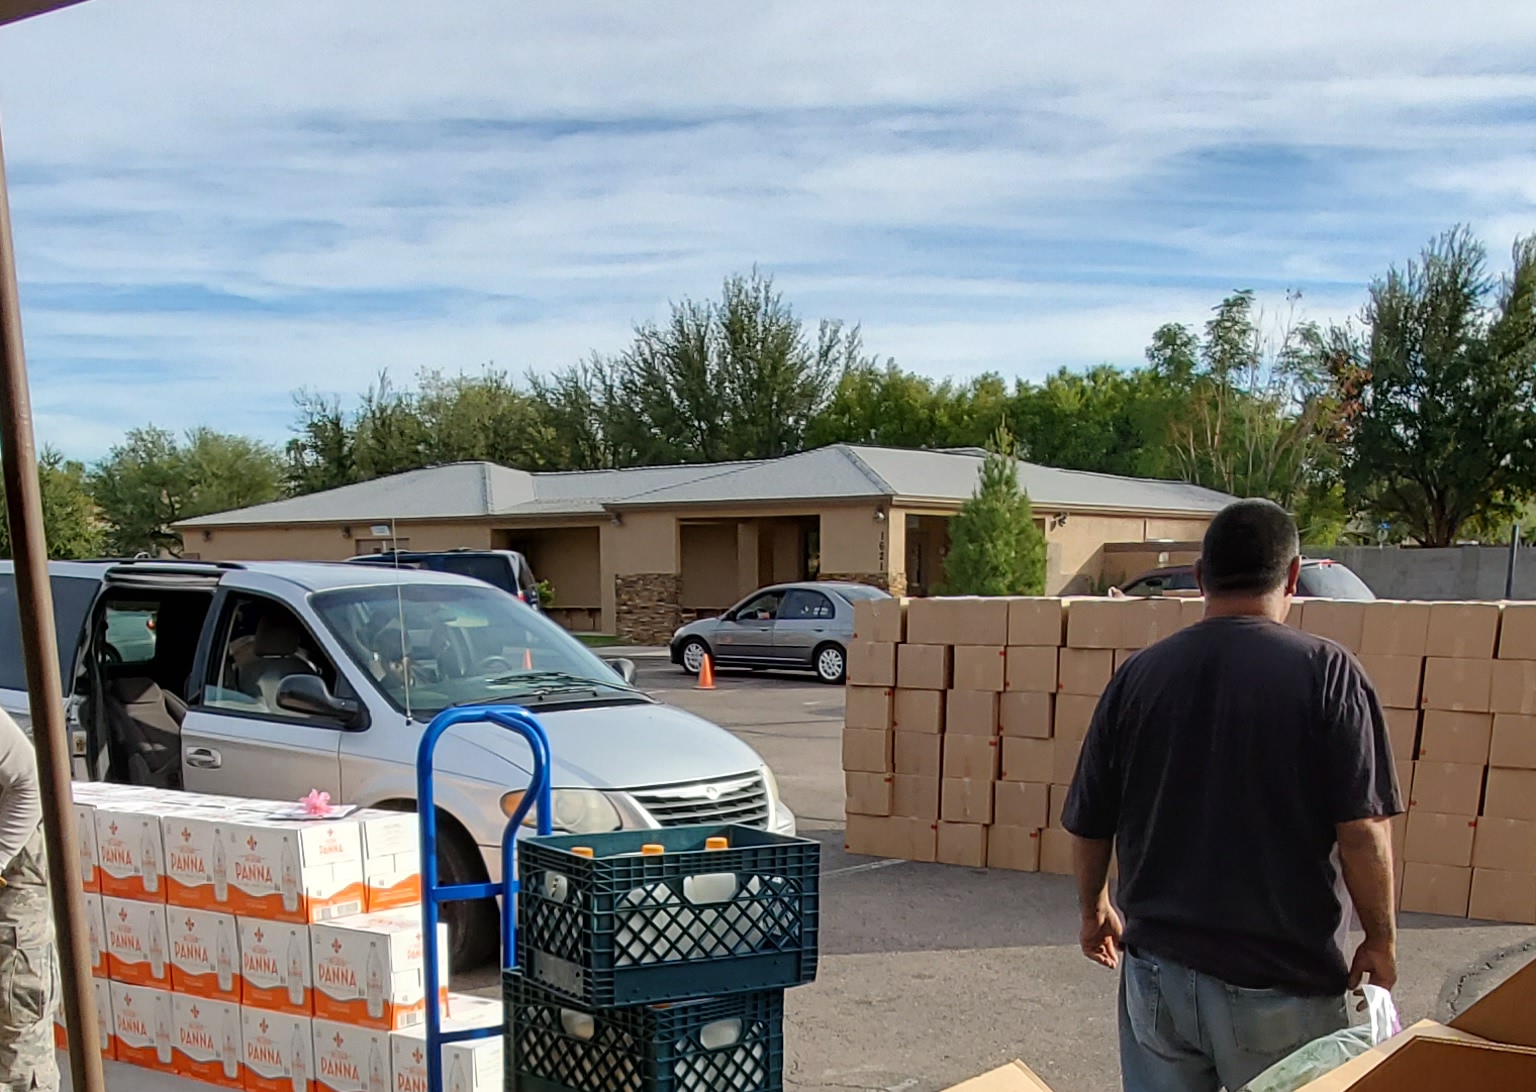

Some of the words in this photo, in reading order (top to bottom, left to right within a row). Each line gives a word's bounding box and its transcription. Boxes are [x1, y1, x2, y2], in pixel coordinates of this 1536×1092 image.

[101, 846, 133, 866] PANNA
[170, 853, 205, 873] PANNA
[235, 862, 272, 883] PANNA
[110, 931, 142, 952] PANNA
[174, 941, 209, 963] PANNA
[243, 954, 278, 975] PANNA
[318, 963, 357, 988] PANNA
[117, 1015, 148, 1036] PANNA
[180, 1027, 214, 1050] PANNA
[247, 1043, 282, 1066] PANNA
[320, 1058, 360, 1081] PANNA
